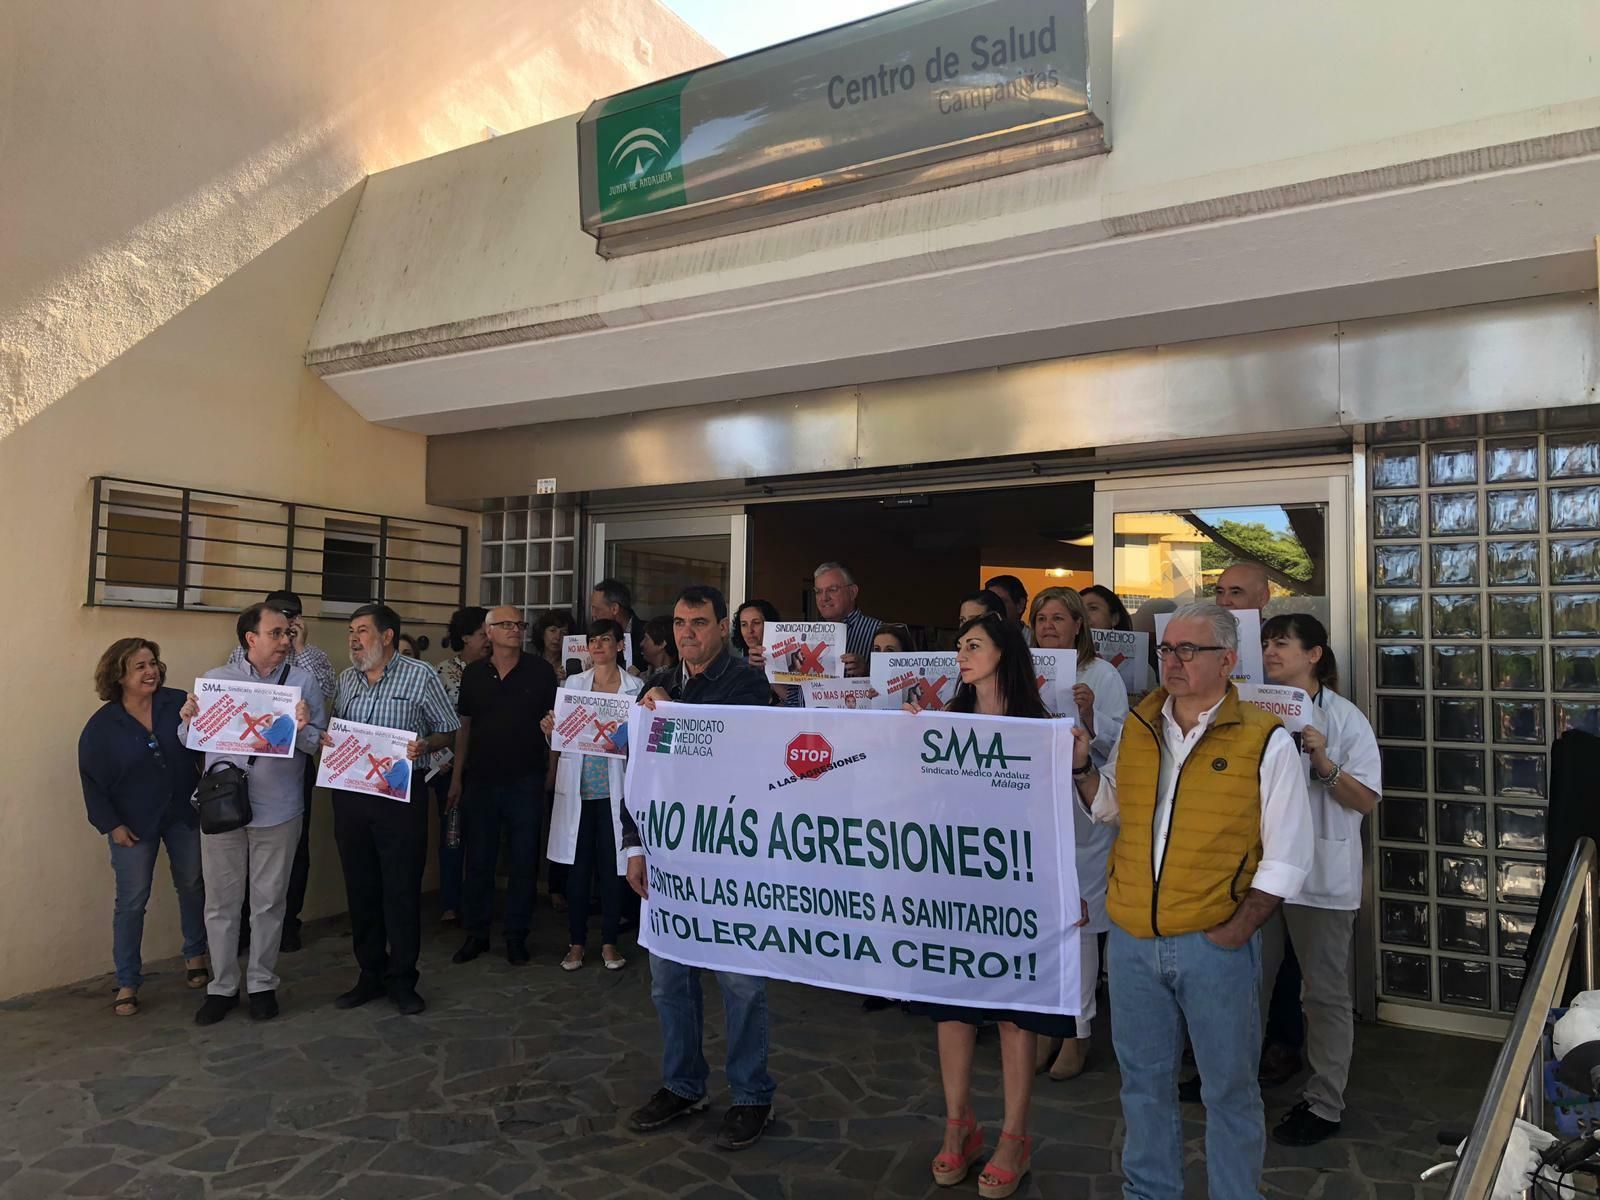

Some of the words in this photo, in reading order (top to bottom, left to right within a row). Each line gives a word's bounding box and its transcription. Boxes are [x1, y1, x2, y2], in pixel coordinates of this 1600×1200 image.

[827, 64, 915, 110] Centro
[925, 46, 960, 84] de
[970, 15, 1057, 71] Salud
[608, 184, 627, 196] JUNTA
[629, 182, 638, 191] DE
[1093, 630, 1135, 644] TOMÉDICO
[202, 683, 225, 693] SMA
[812, 691, 823, 700] NO
[823, 691, 838, 699] MAS
[840, 689, 869, 699] AGRESIO
[196, 707, 224, 732] DENUNCIA
[222, 698, 235, 710] LAS
[203, 705, 236, 735] AGRESIONES
[676, 718, 724, 733] SINDICATO
[674, 731, 713, 745] MÉDICO
[673, 744, 713, 757] MÁLAGA
[921, 726, 1031, 770] SMA
[789, 749, 829, 762] STOP
[768, 783, 776, 791] A
[777, 775, 798, 788] LAS
[800, 752, 867, 780] AGRESIONES
[921, 766, 959, 776] Sindicato
[961, 768, 992, 778] Médico
[994, 770, 1031, 780] Andaluz
[991, 779, 1031, 791] Málaga
[692, 795, 758, 858] MÁS
[768, 811, 1034, 883] AGRESIONES!!
[650, 864, 698, 902] CONTRA
[701, 877, 737, 907] LAS
[744, 881, 876, 921] AGRESIONES
[881, 895, 897, 924] A
[902, 896, 1038, 940] SANITARIOS
[650, 908, 882, 964] ¡¡TOLERANCIA
[891, 939, 1037, 981] CERO!!
